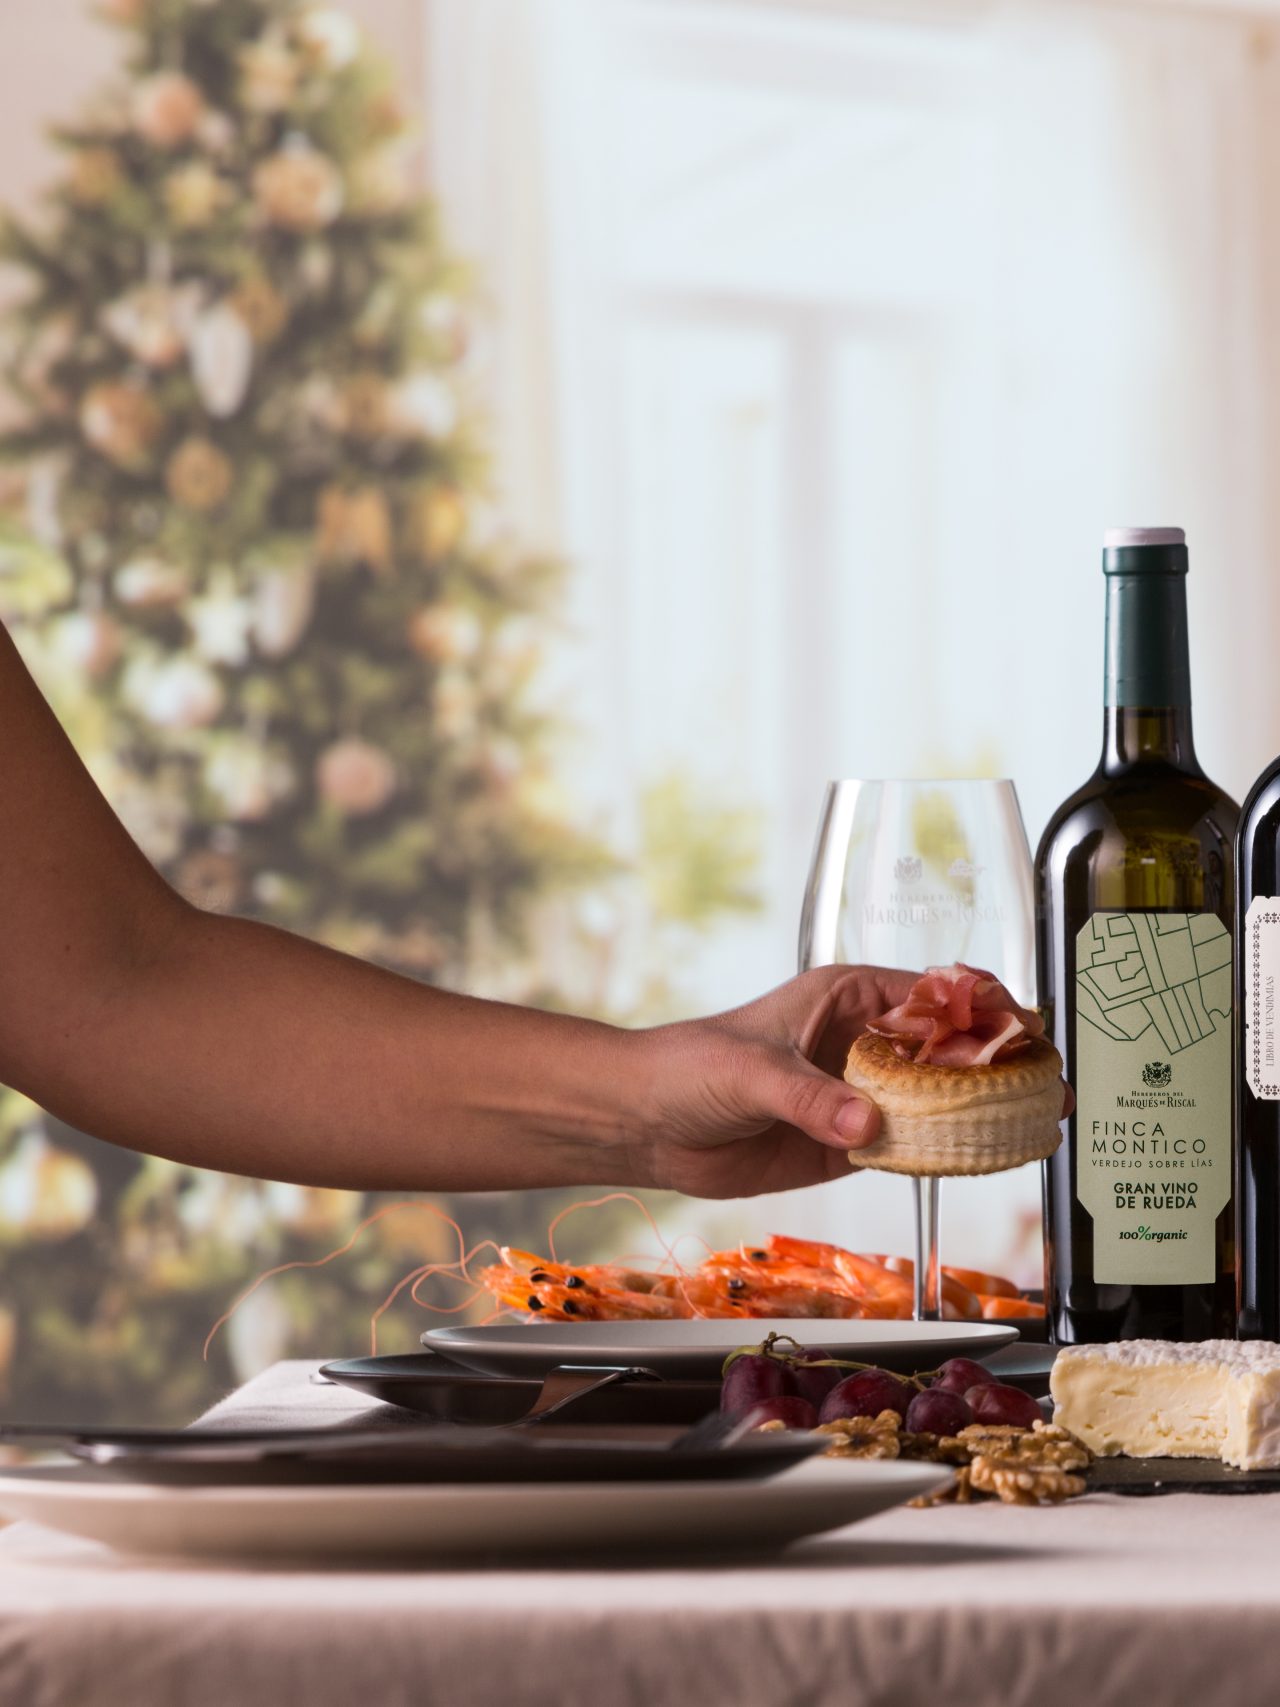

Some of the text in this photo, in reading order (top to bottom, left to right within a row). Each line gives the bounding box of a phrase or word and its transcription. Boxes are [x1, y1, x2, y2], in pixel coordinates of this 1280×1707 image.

[1265, 975, 1275, 1027] VENDIMIAS
[1265, 1041, 1275, 1066] LIBRO
[1116, 1096, 1159, 1110] MARQUÉS
[1167, 1096, 1197, 1108] RISCAL
[1092, 1120, 1165, 1137] FINCA
[1092, 1138, 1206, 1154] MONTICO
[1091, 1158, 1213, 1168] VERDEJO SOBRE LÍAS
[1113, 1182, 1198, 1194] GRAN VINO
[1115, 1195, 1197, 1209] DE RUEDA
